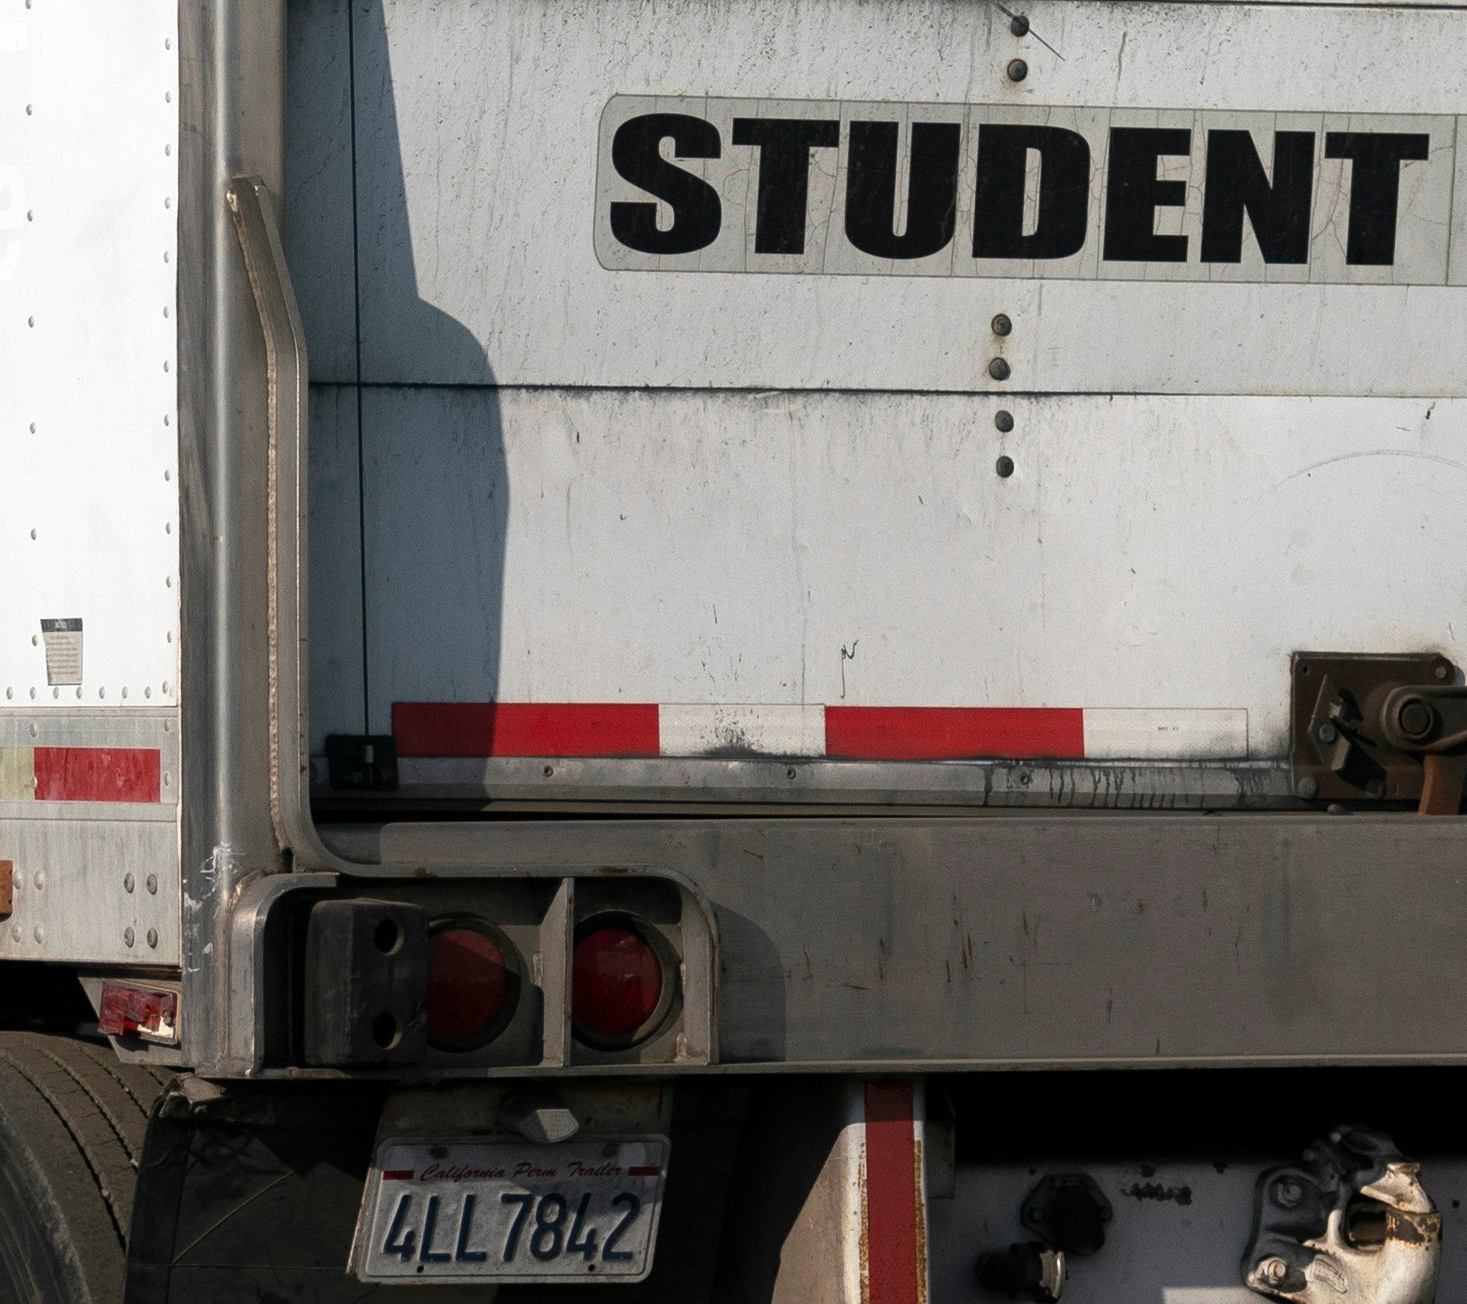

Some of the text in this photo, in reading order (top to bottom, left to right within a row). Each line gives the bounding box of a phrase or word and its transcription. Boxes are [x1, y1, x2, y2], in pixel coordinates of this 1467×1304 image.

[609, 113, 1429, 269] STUDENT
[420, 1161, 623, 1182] California Perm Trailer
[383, 1192, 641, 1262] 4LL7842
